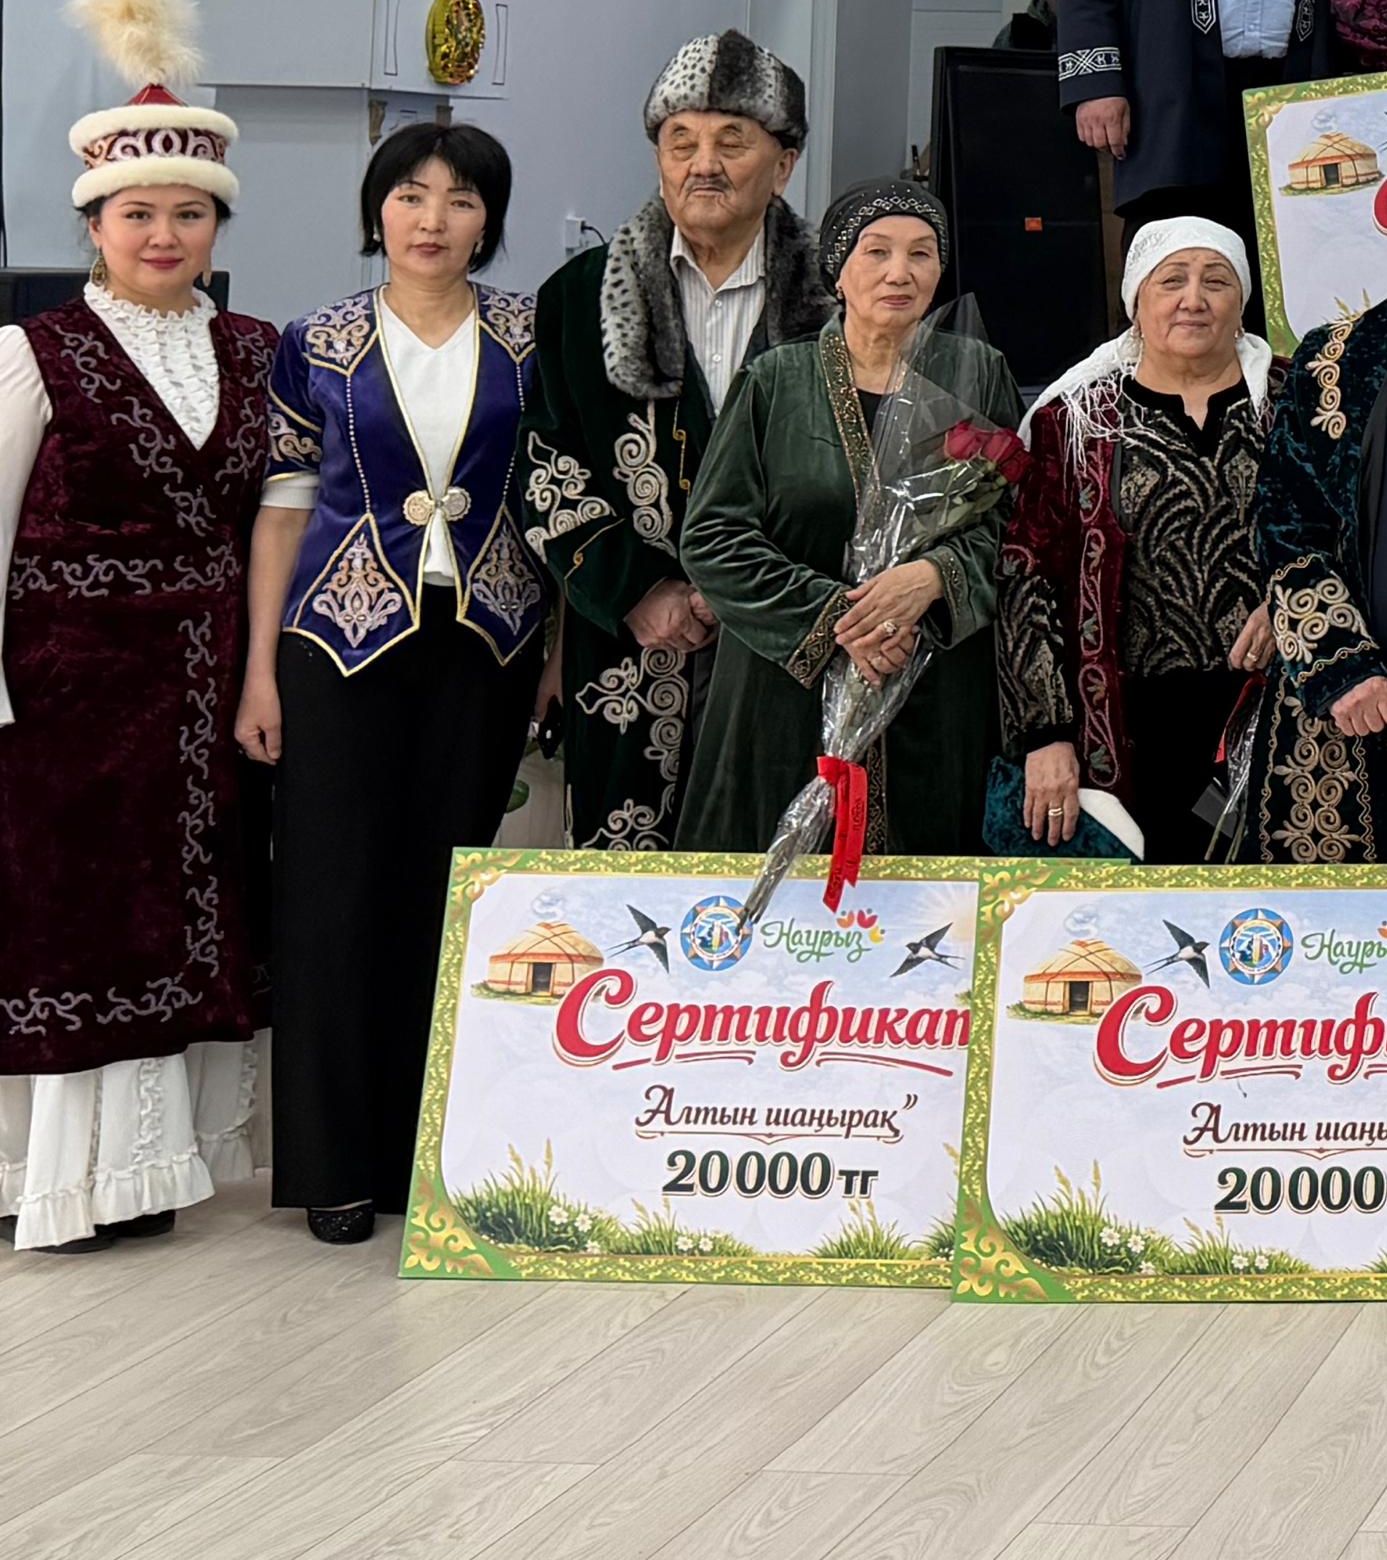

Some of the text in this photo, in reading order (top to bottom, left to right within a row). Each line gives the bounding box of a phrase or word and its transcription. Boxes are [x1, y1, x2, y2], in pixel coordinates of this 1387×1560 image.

[760, 918, 872, 963] Наурыз
[634, 1084, 758, 1129] Алтын
[1183, 1102, 1308, 1146] Алтын
